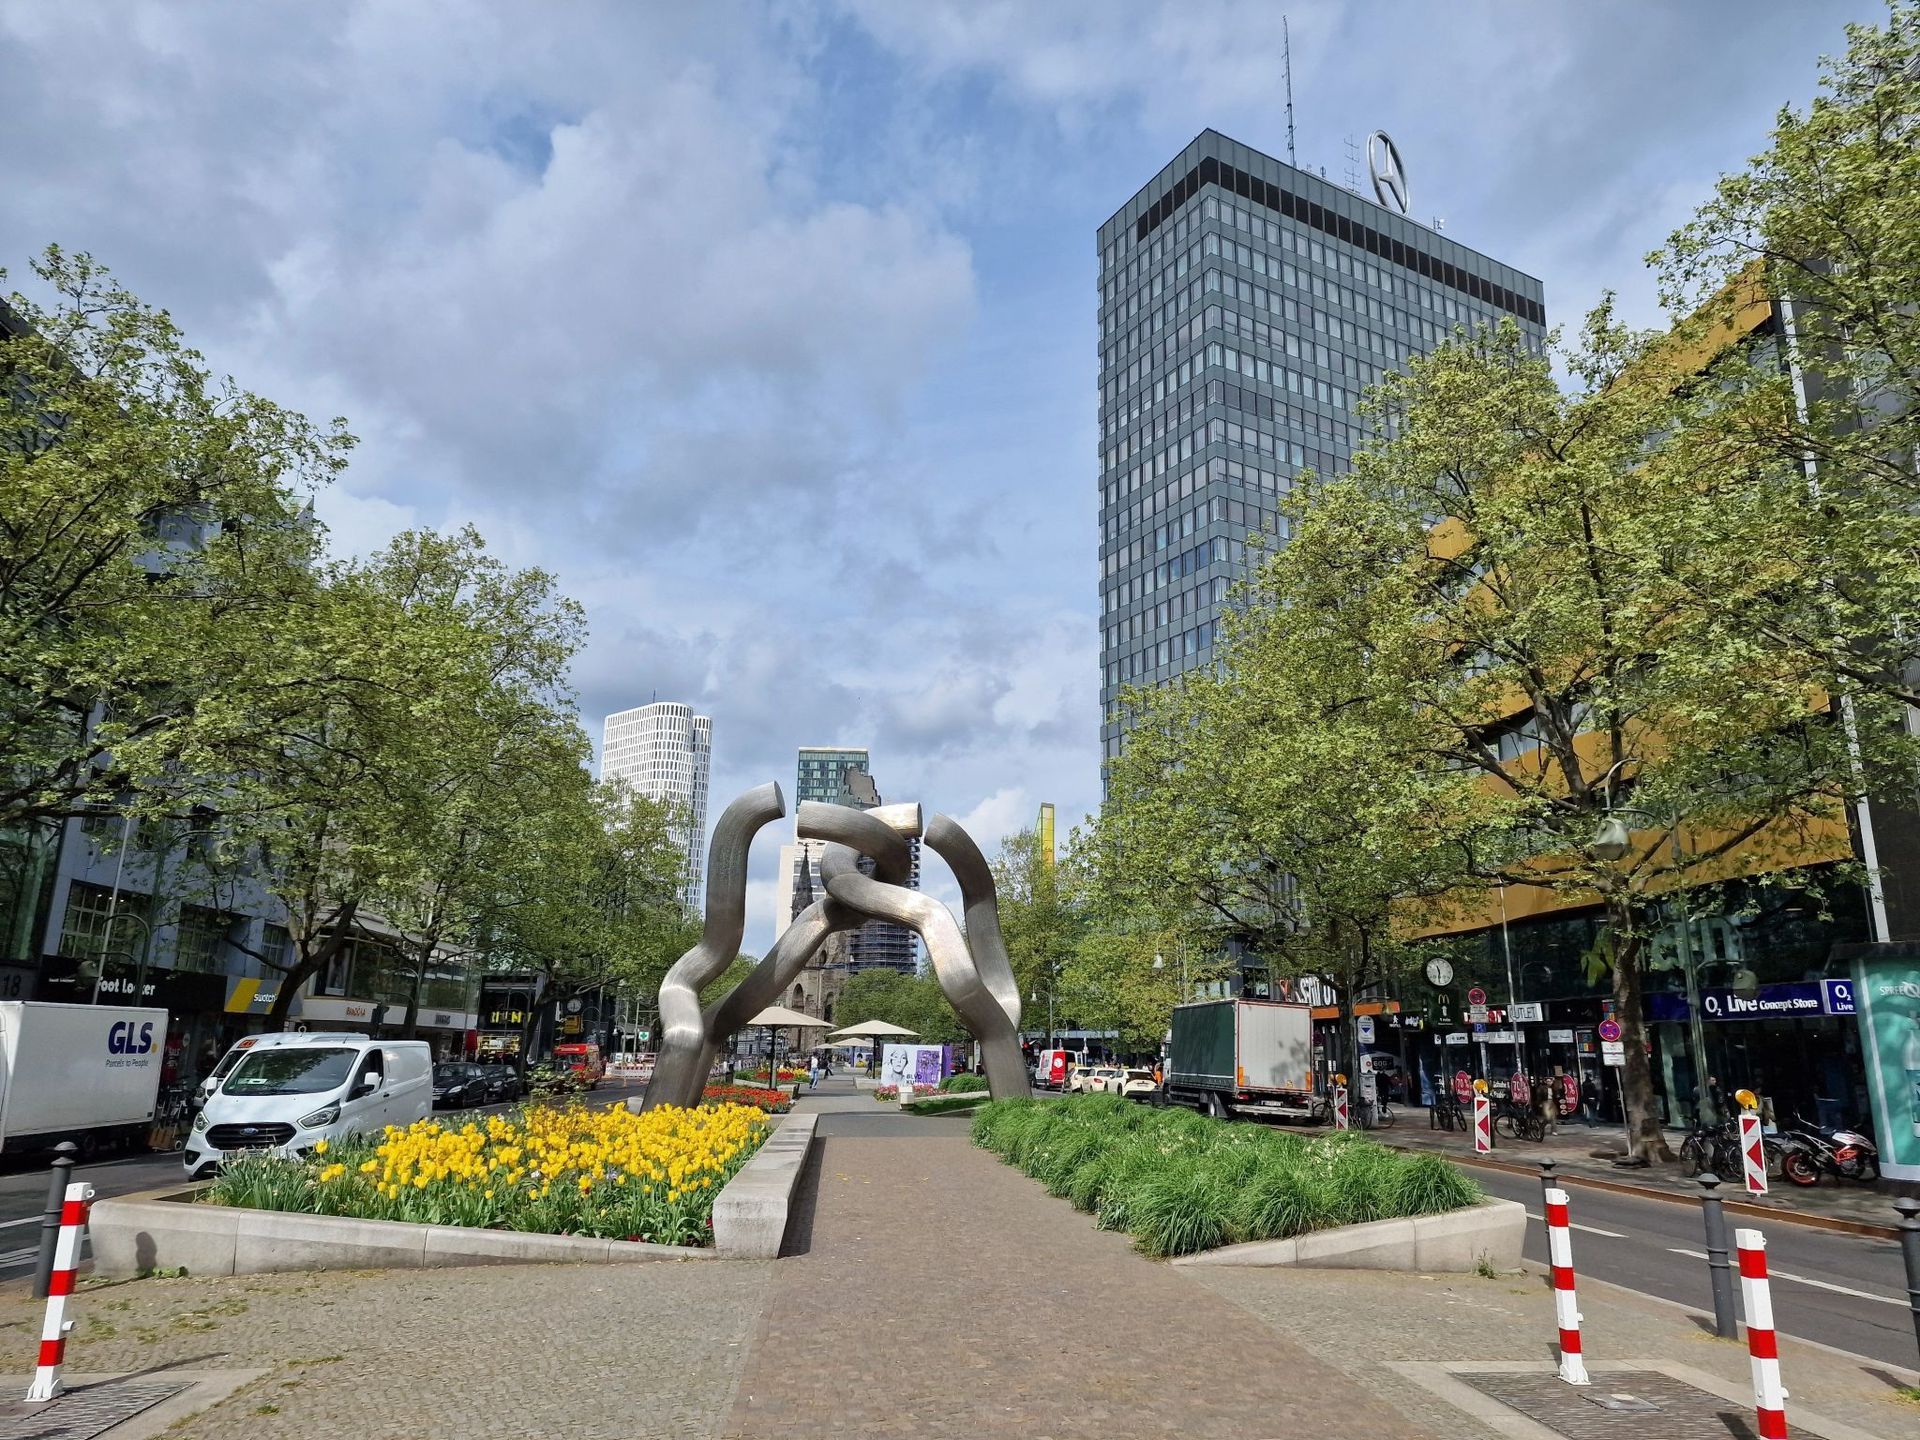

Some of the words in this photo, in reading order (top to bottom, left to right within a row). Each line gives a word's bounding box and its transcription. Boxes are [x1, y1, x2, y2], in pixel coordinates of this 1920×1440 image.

[122, 978, 156, 996] Loer
[1726, 994, 1758, 1012] Live
[1759, 1000, 1792, 1012] Concept
[1793, 998, 1818, 1009] Store
[1836, 1002, 1854, 1011] Live
